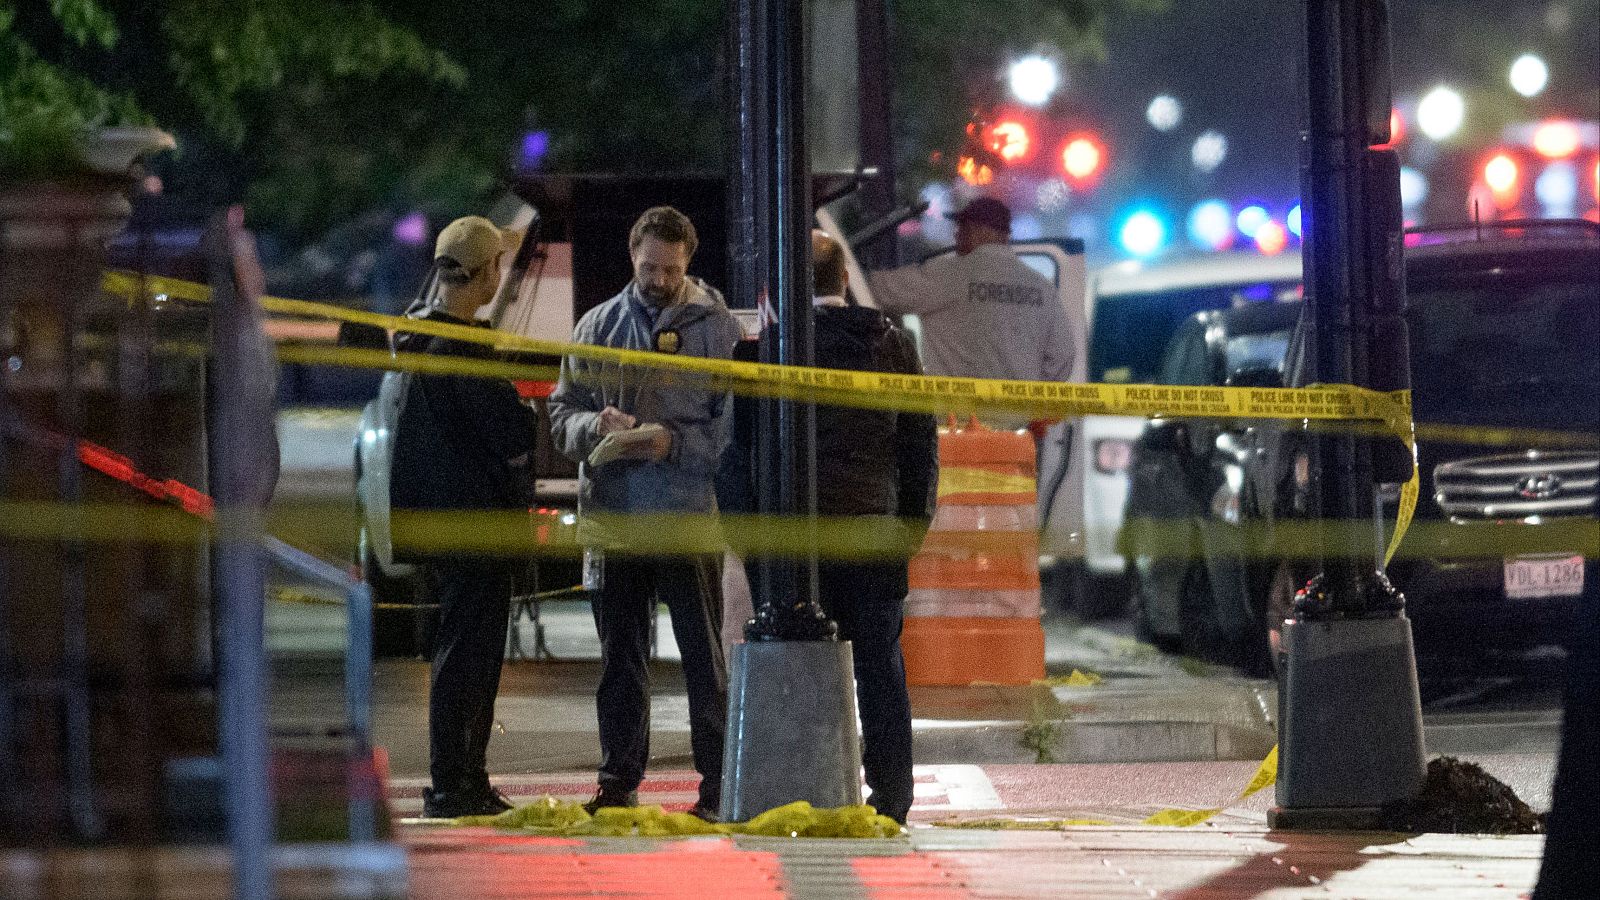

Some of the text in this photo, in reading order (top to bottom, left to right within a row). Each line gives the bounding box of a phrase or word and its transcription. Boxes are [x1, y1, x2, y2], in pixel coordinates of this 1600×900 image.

[924, 380, 934, 393] DO
[1001, 383, 1099, 399] POLICE LINE DO NOT CROSS
[1125, 388, 1224, 403] POLICE LINE DO NOT CROSS
[1250, 390, 1276, 403] POLICE
[1278, 391, 1294, 404] LINE
[1297, 391, 1307, 404] DO
[1309, 392, 1324, 404] NOT
